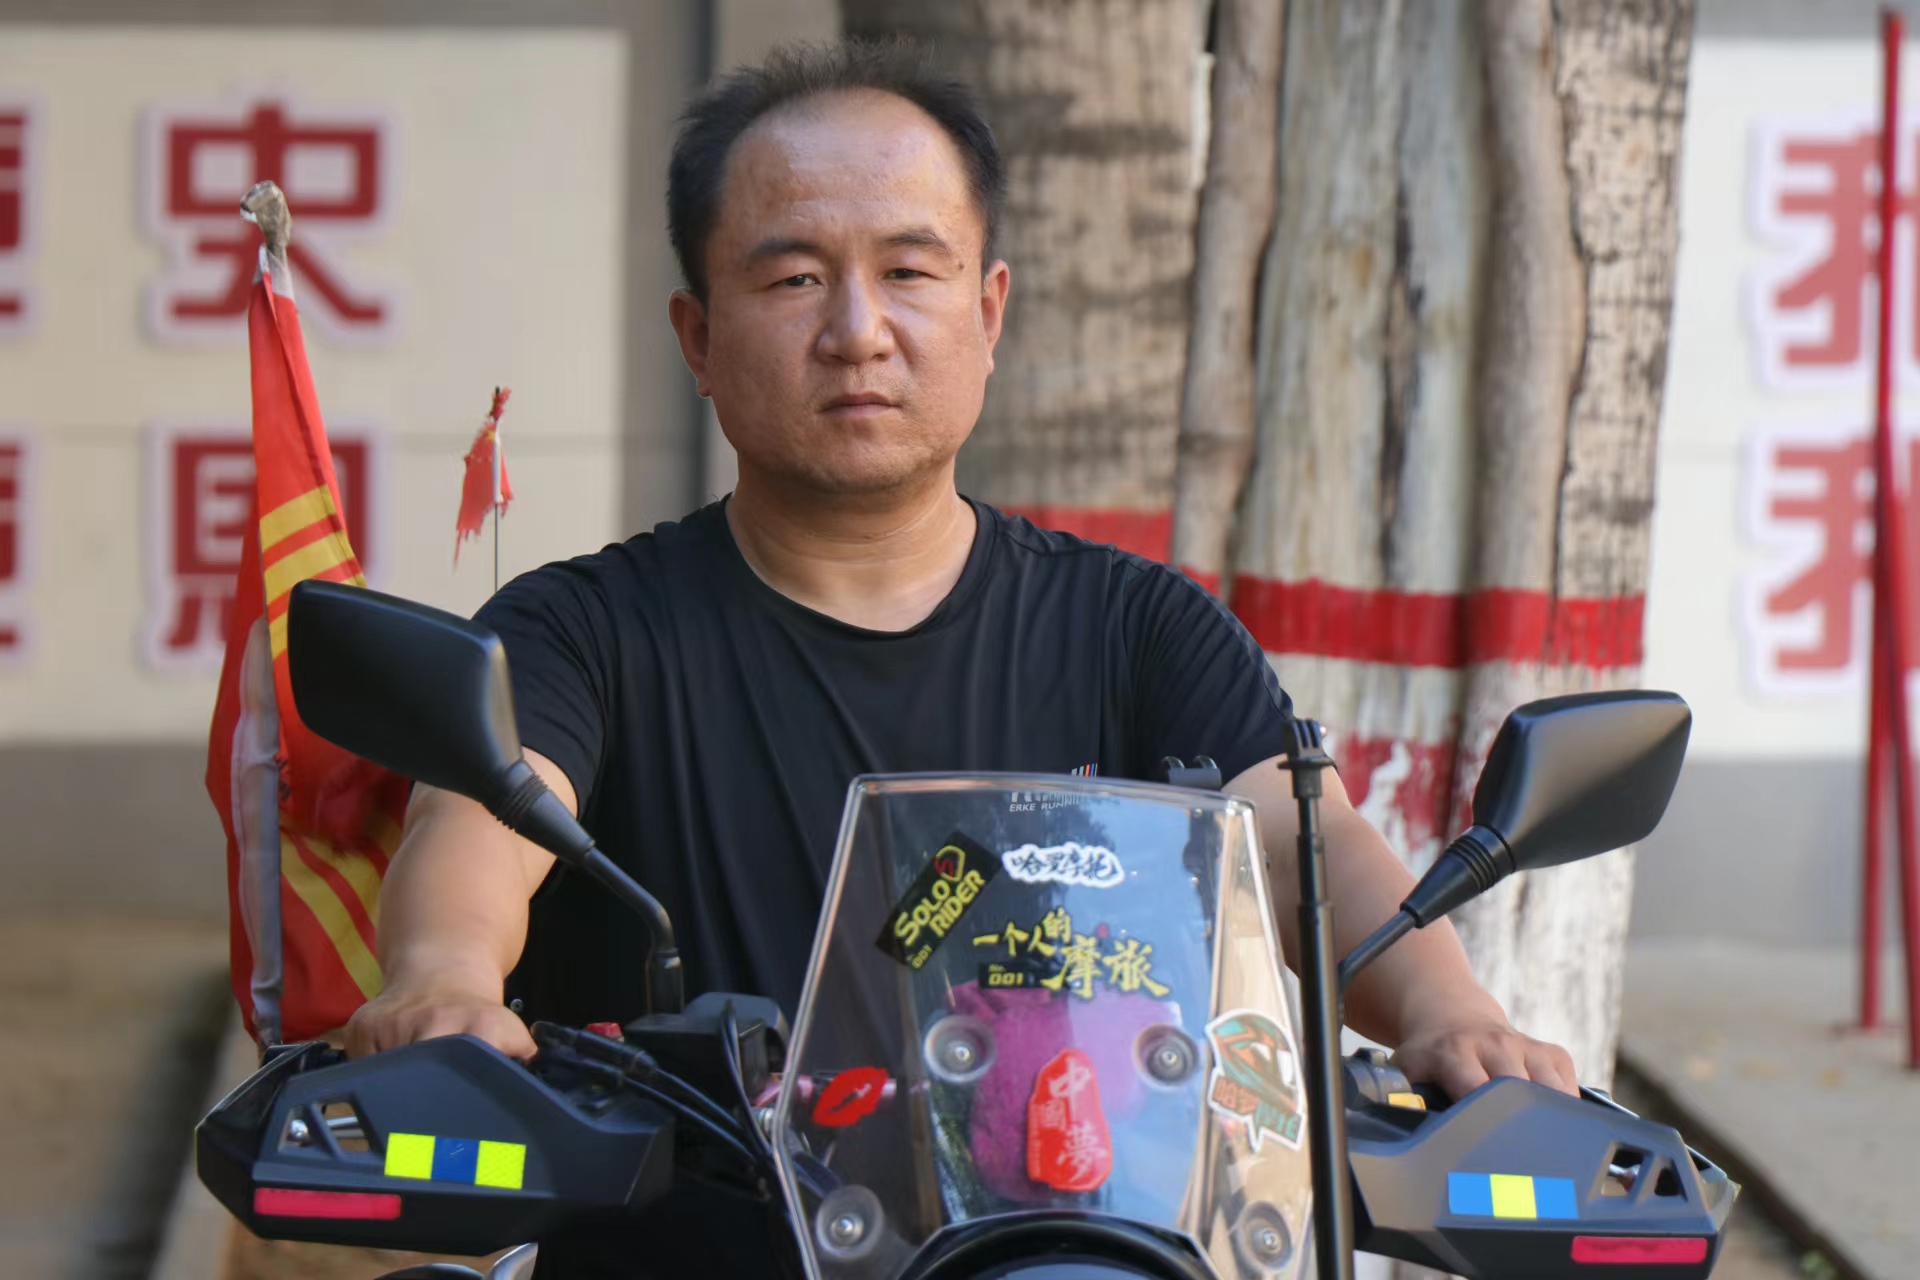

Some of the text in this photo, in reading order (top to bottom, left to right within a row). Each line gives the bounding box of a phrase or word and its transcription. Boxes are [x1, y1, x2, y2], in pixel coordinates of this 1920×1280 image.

[165, 101, 383, 322] 史
[1009, 803, 1036, 812] ERKE
[894, 879, 952, 946] SOLO
[929, 868, 986, 938] RIDER
